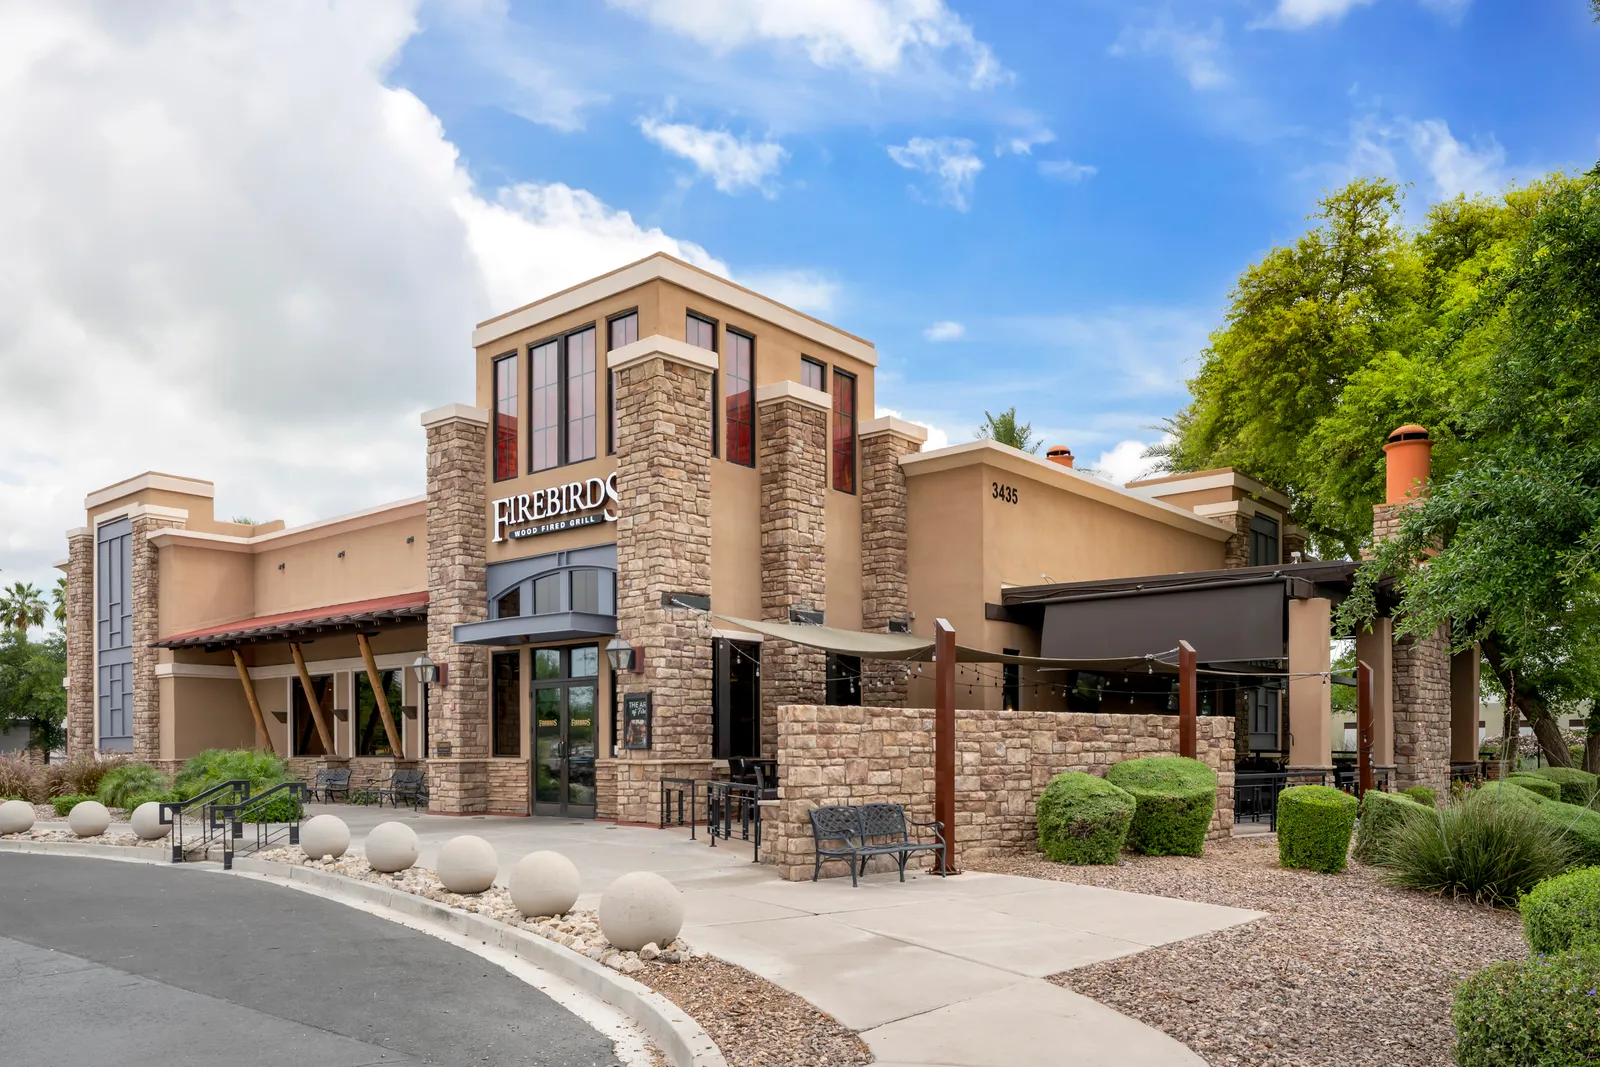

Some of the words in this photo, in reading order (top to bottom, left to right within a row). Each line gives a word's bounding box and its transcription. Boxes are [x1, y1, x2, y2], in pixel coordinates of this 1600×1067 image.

[992, 482, 1018, 504] 3435
[492, 471, 618, 542] FIREBIRDS
[514, 528, 537, 537] WOOD
[541, 522, 566, 532] FIRED
[569, 516, 595, 527] GRILL
